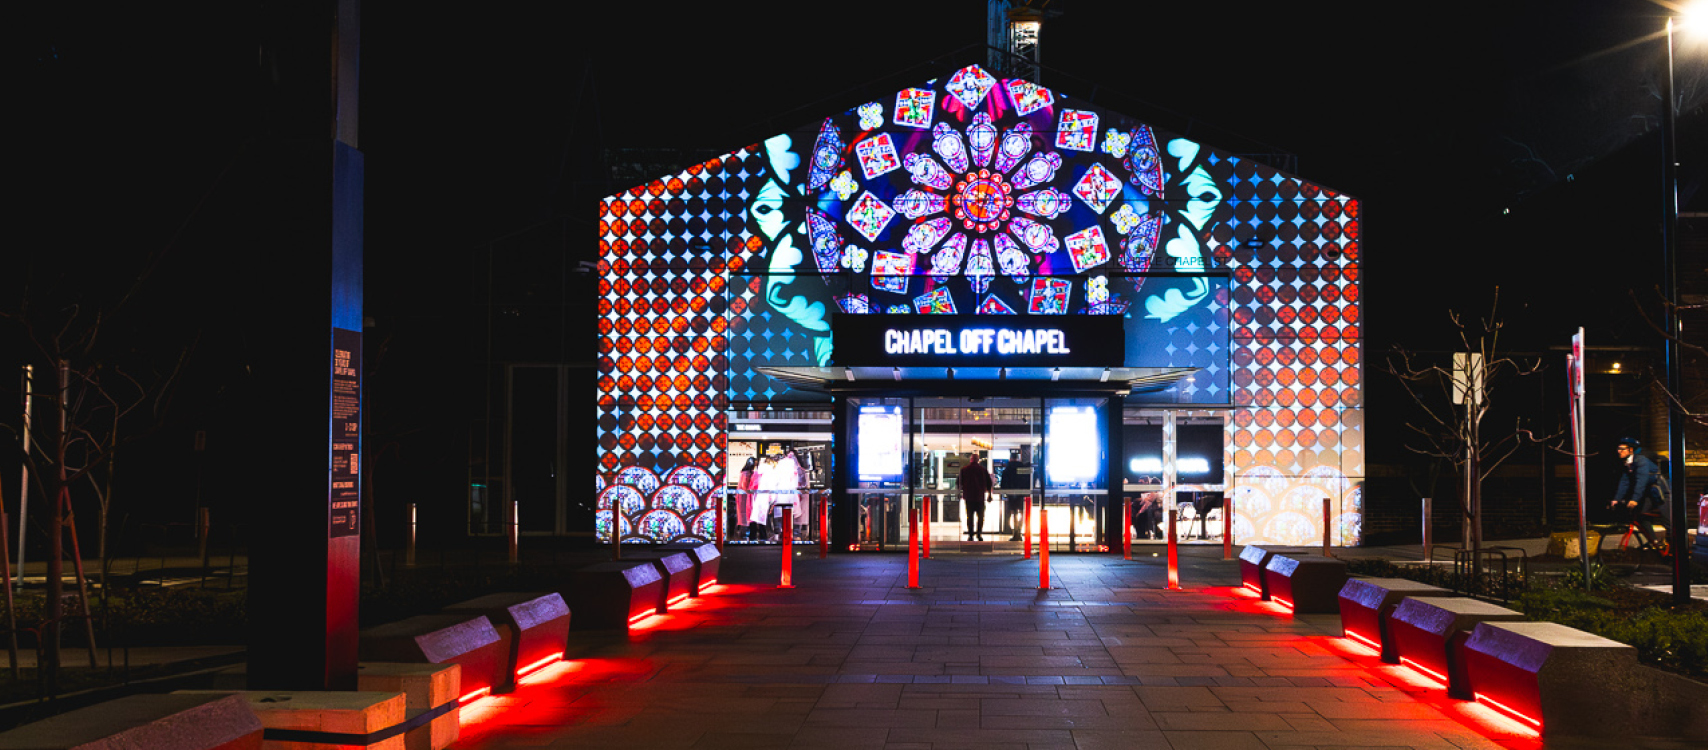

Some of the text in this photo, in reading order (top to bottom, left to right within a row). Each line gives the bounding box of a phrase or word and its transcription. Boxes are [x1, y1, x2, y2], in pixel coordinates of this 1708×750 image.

[1165, 256, 1209, 266] CHAPEL
[885, 328, 1070, 354] CHAPEL OFF CHAPEL
